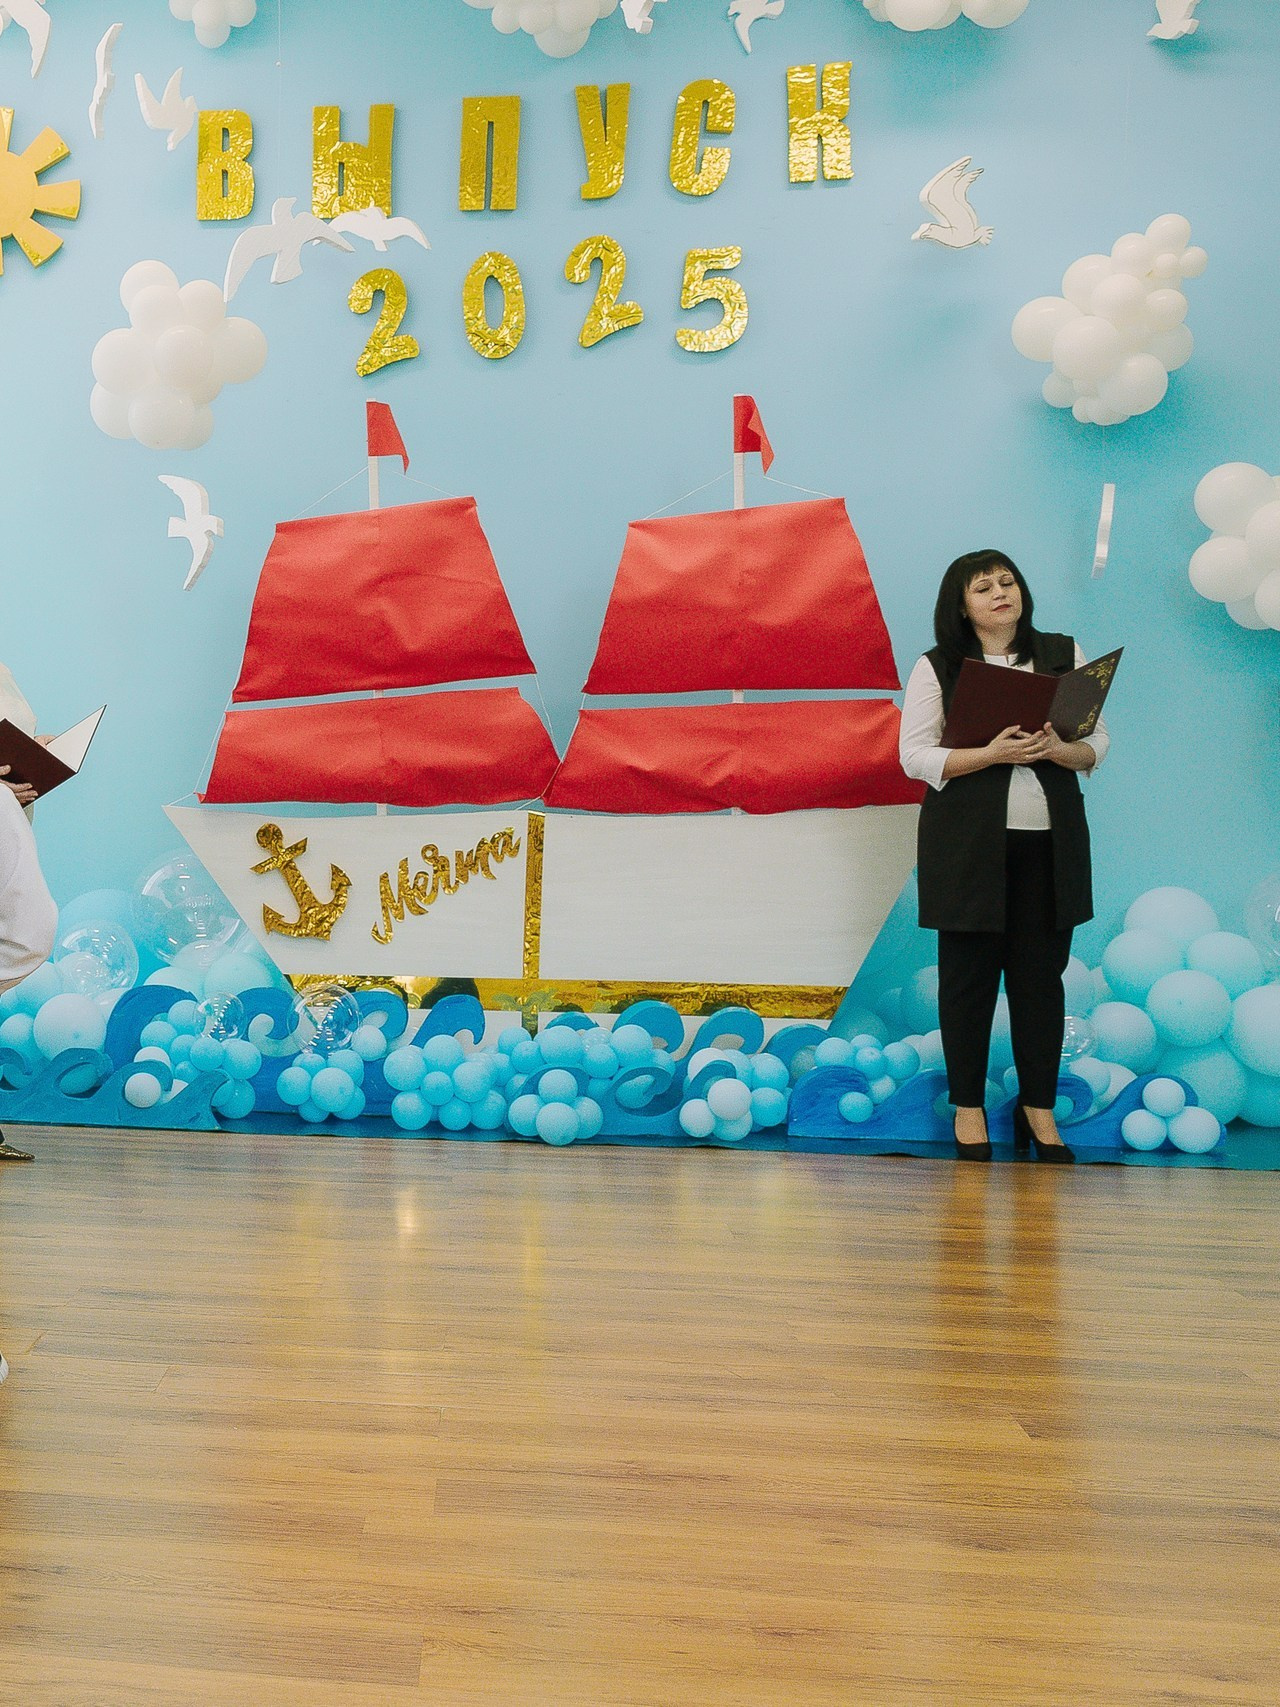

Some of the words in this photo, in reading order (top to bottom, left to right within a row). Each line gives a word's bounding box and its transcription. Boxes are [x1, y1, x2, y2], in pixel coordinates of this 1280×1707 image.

[196, 61, 853, 221] ВЫПУСК
[347, 234, 749, 377] 2025
[371, 826, 521, 945] Мечта
